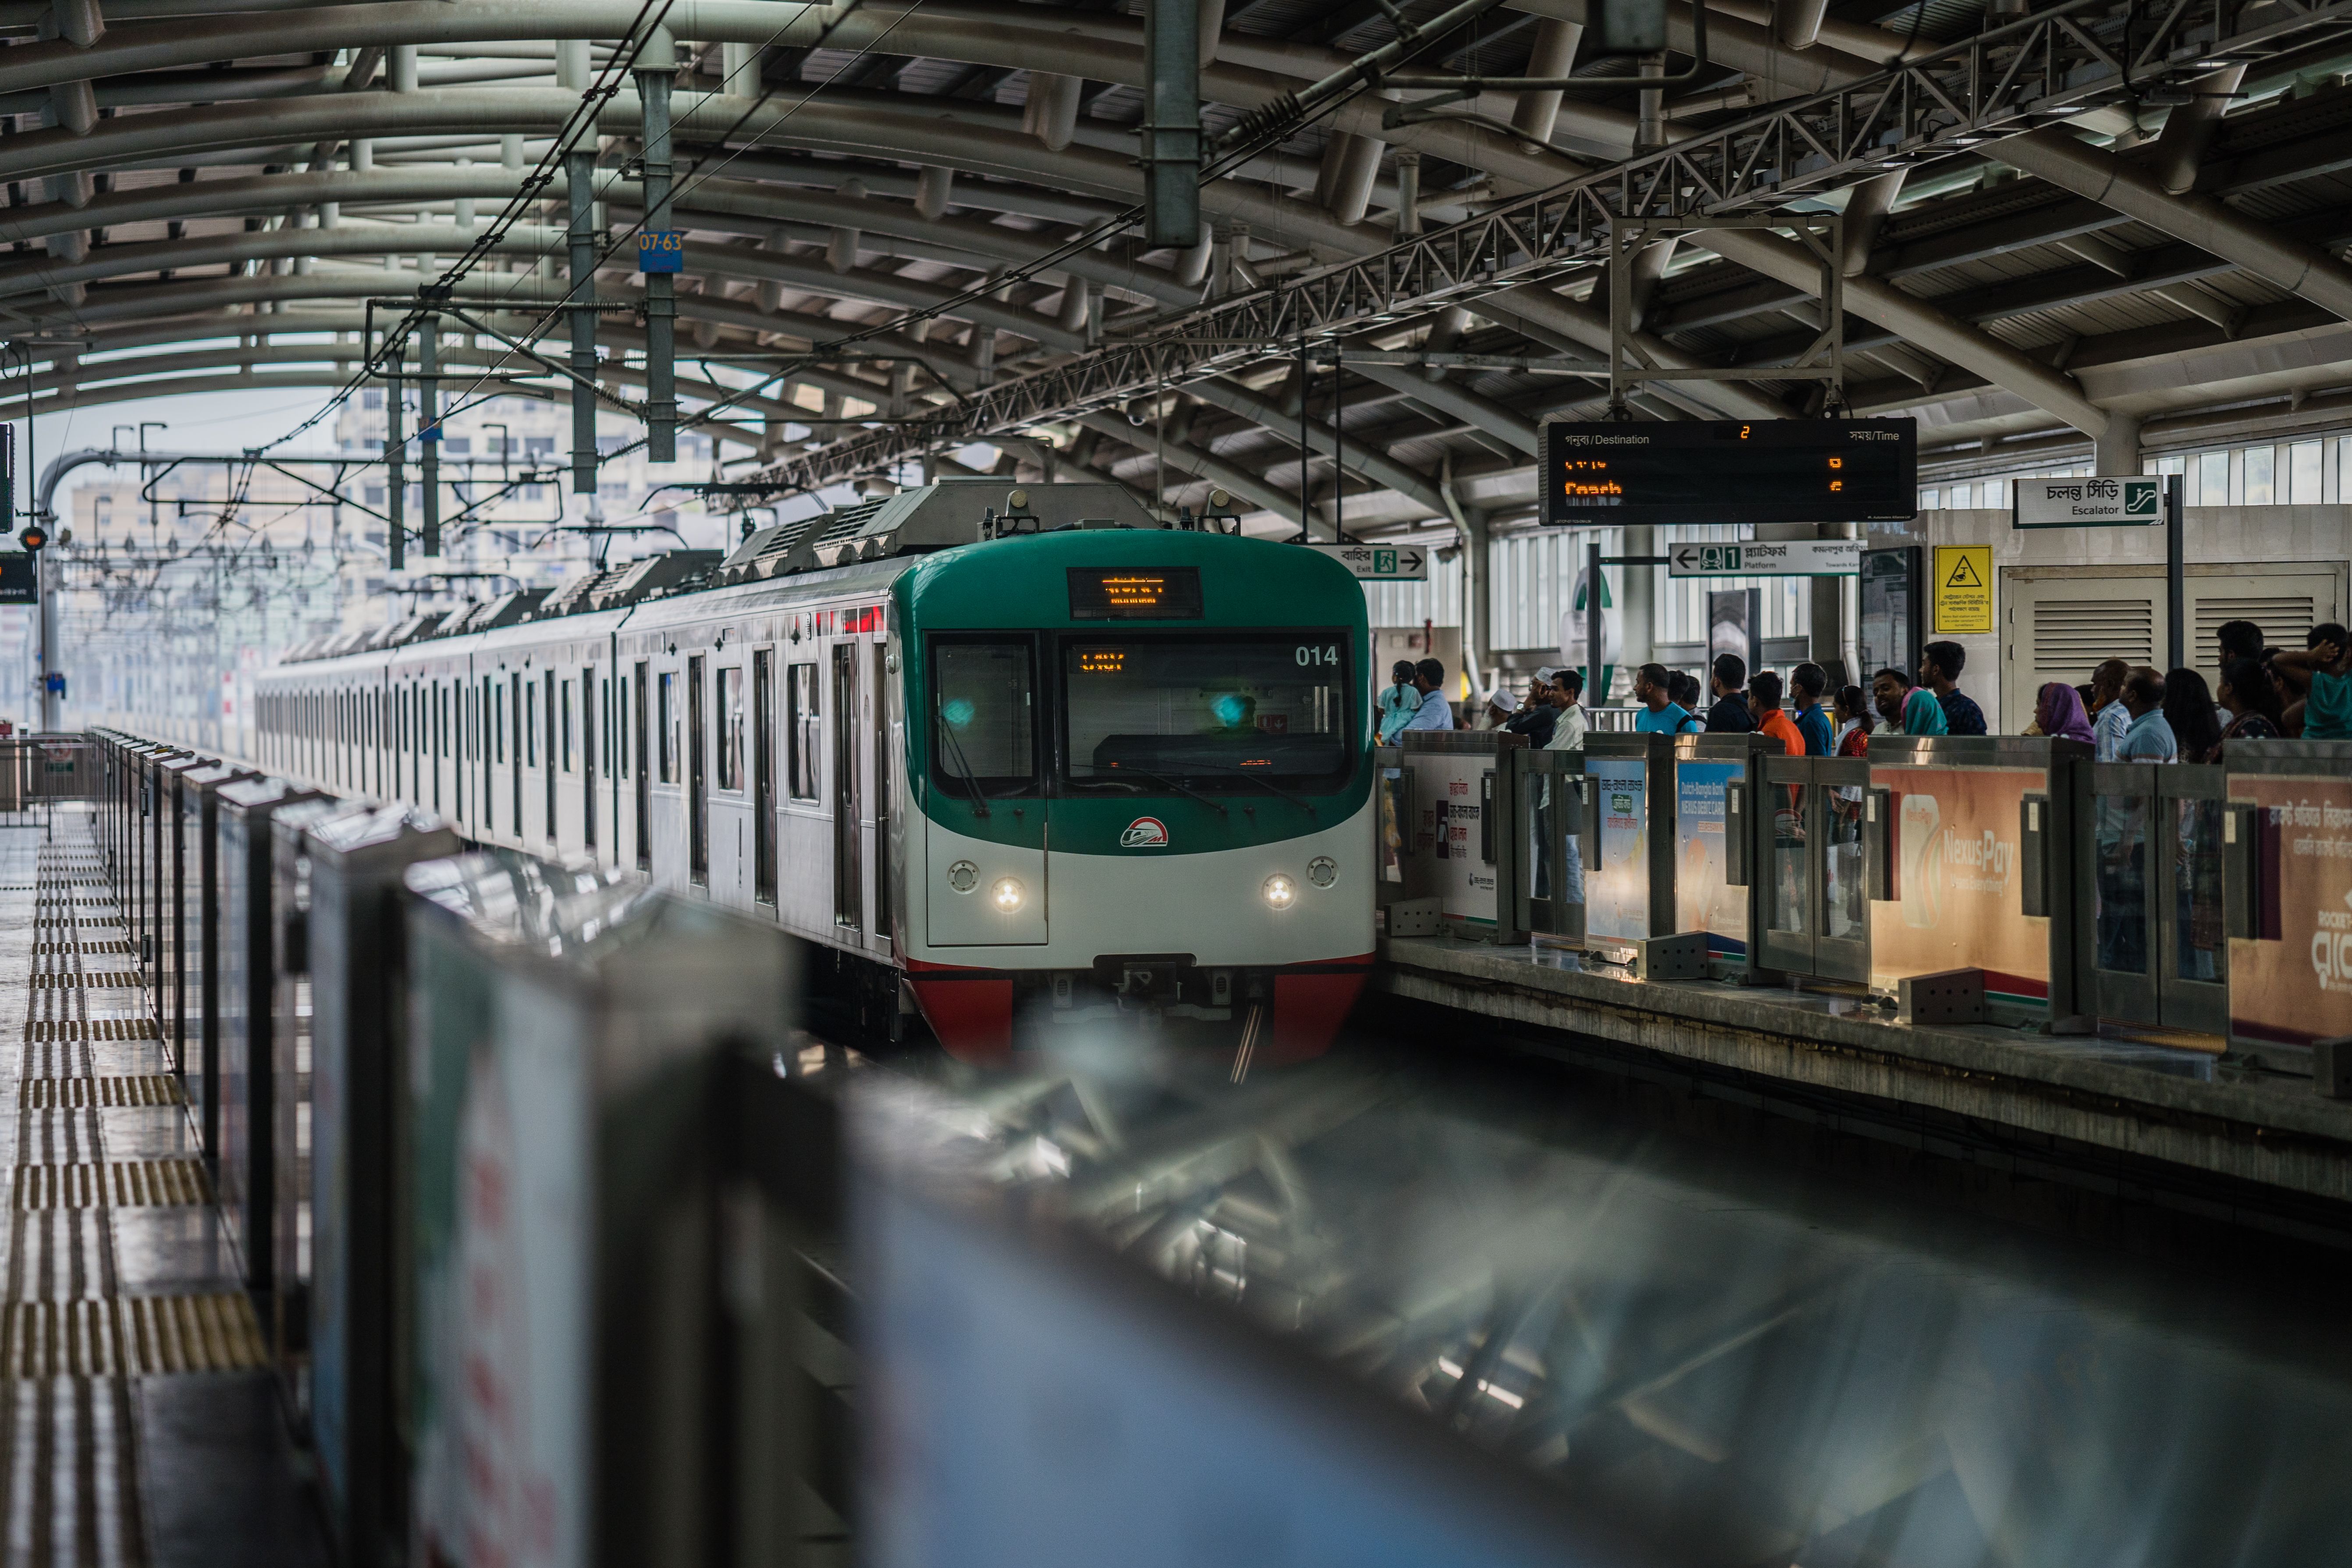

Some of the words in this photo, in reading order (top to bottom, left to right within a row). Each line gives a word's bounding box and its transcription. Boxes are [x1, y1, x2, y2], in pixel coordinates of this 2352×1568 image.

[1741, 425, 1750, 439] 2
[2046, 485, 2082, 501] চলন্ত
[2086, 480, 2119, 500] সিঁড়ি
[2072, 505, 2120, 515] Escalator
[1341, 547, 1371, 561] বাহির
[1727, 548, 1737, 569] 1
[1744, 544, 1787, 558] প্ল্যাটফর্ম
[1294, 645, 1338, 667] 014
[1943, 829, 2014, 885] NexusPay
[1969, 875, 2003, 898] Everything
